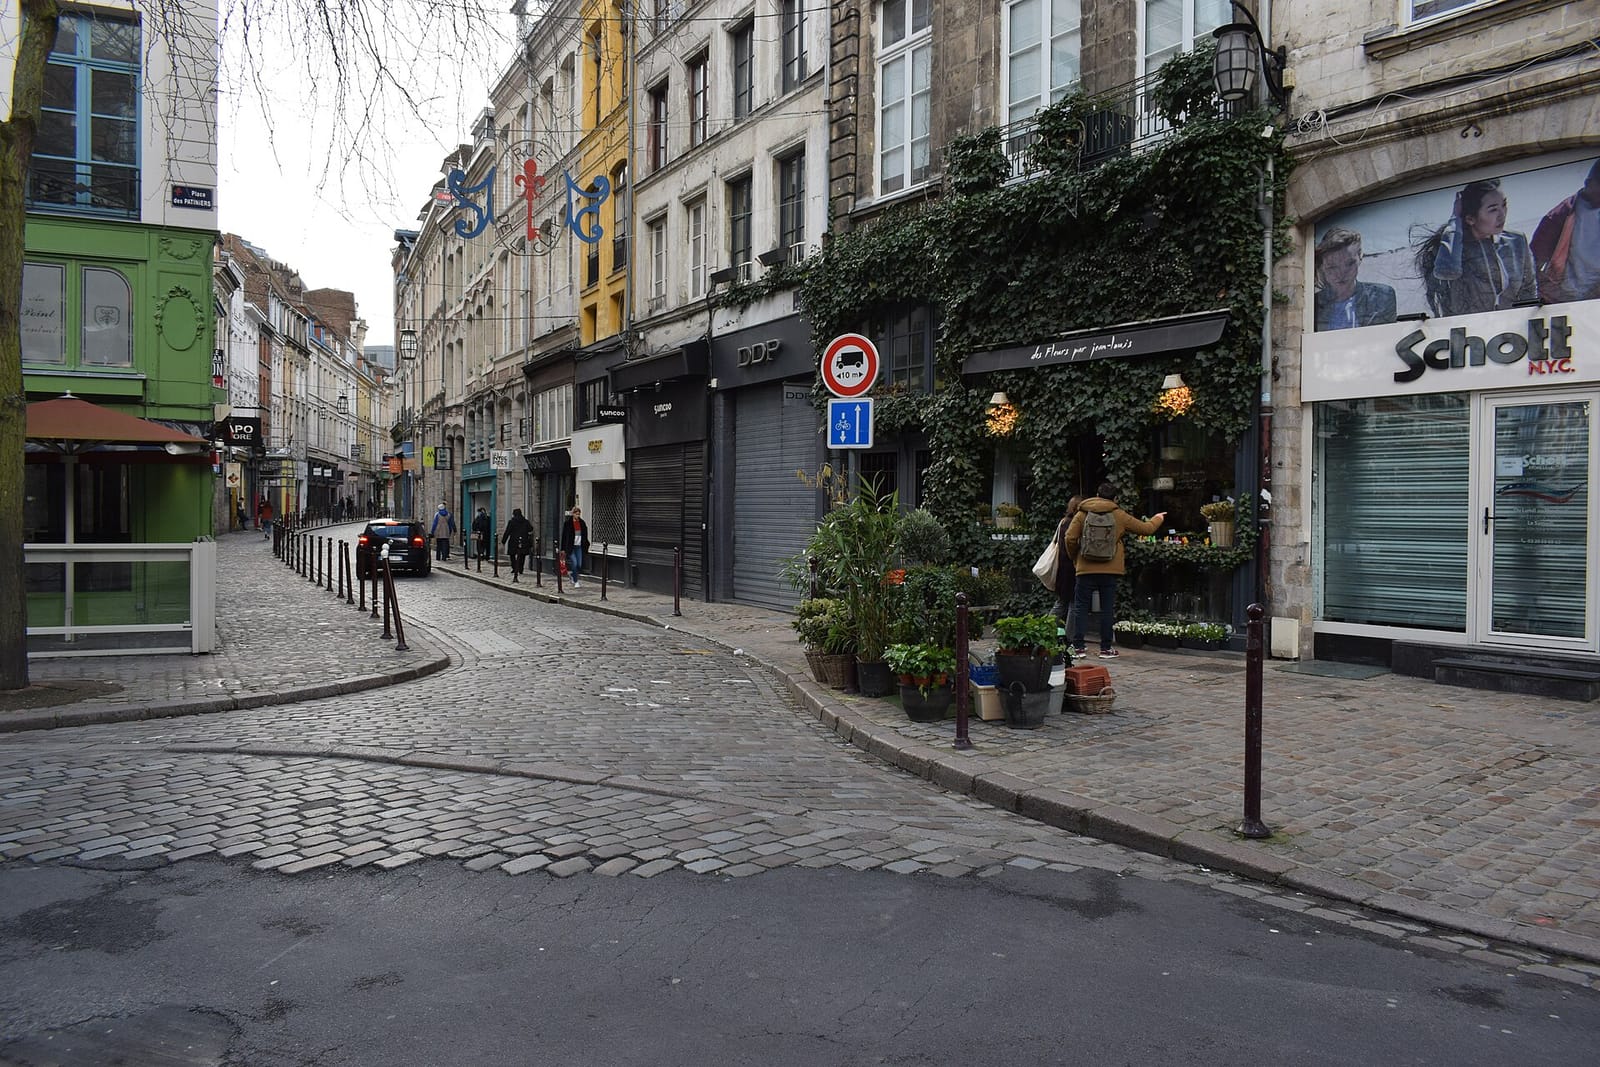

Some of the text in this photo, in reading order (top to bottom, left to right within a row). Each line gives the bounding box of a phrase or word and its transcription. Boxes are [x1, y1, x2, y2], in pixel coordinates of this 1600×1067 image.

[513, 143, 550, 163] RUE
[184, 198, 211, 207] PATINIERS
[191, 190, 206, 198] Place
[737, 338, 781, 368] DDP
[1030, 345, 1042, 360] des
[1393, 315, 1573, 384] Schott
[841, 370, 850, 379] 10
[1528, 357, 1576, 376] N.Y.C.
